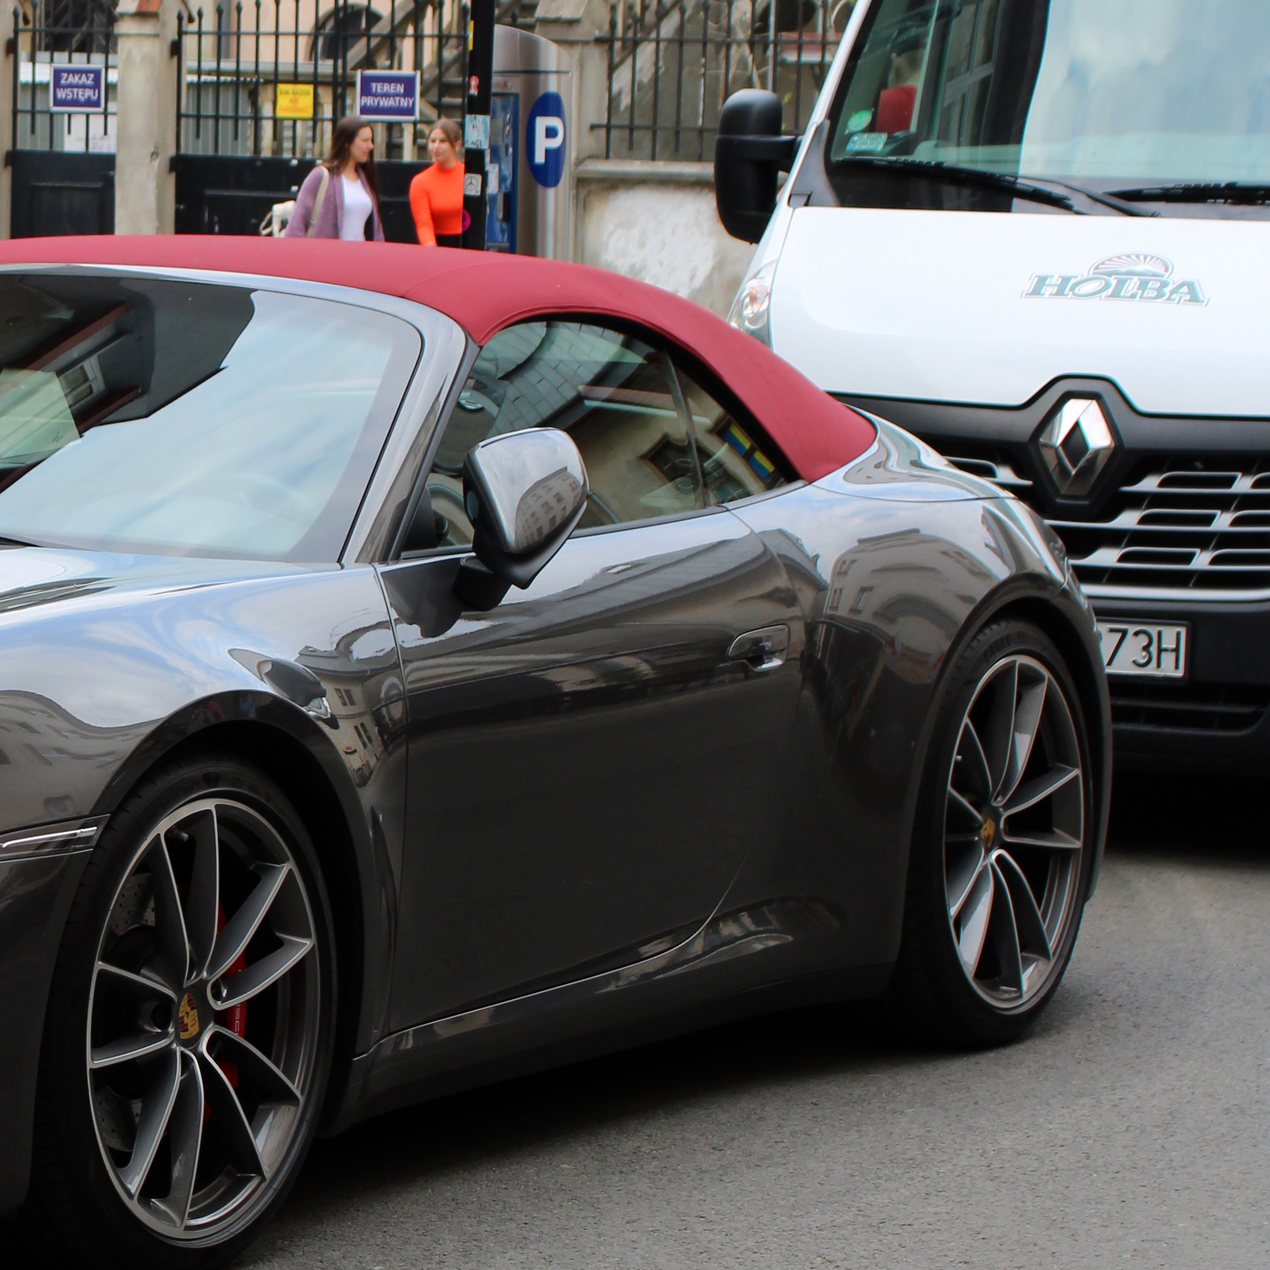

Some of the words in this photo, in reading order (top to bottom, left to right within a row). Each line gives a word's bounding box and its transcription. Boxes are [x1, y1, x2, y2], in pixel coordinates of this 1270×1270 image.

[61, 72, 94, 84] ZAKAZ
[56, 88, 99, 102] WSTĘPU
[371, 82, 405, 94] TEREN
[360, 96, 415, 108] PRYWATNY
[533, 116, 564, 163] P
[1021, 273, 1209, 305] HOLBA
[1099, 625, 1182, 671] 73H
